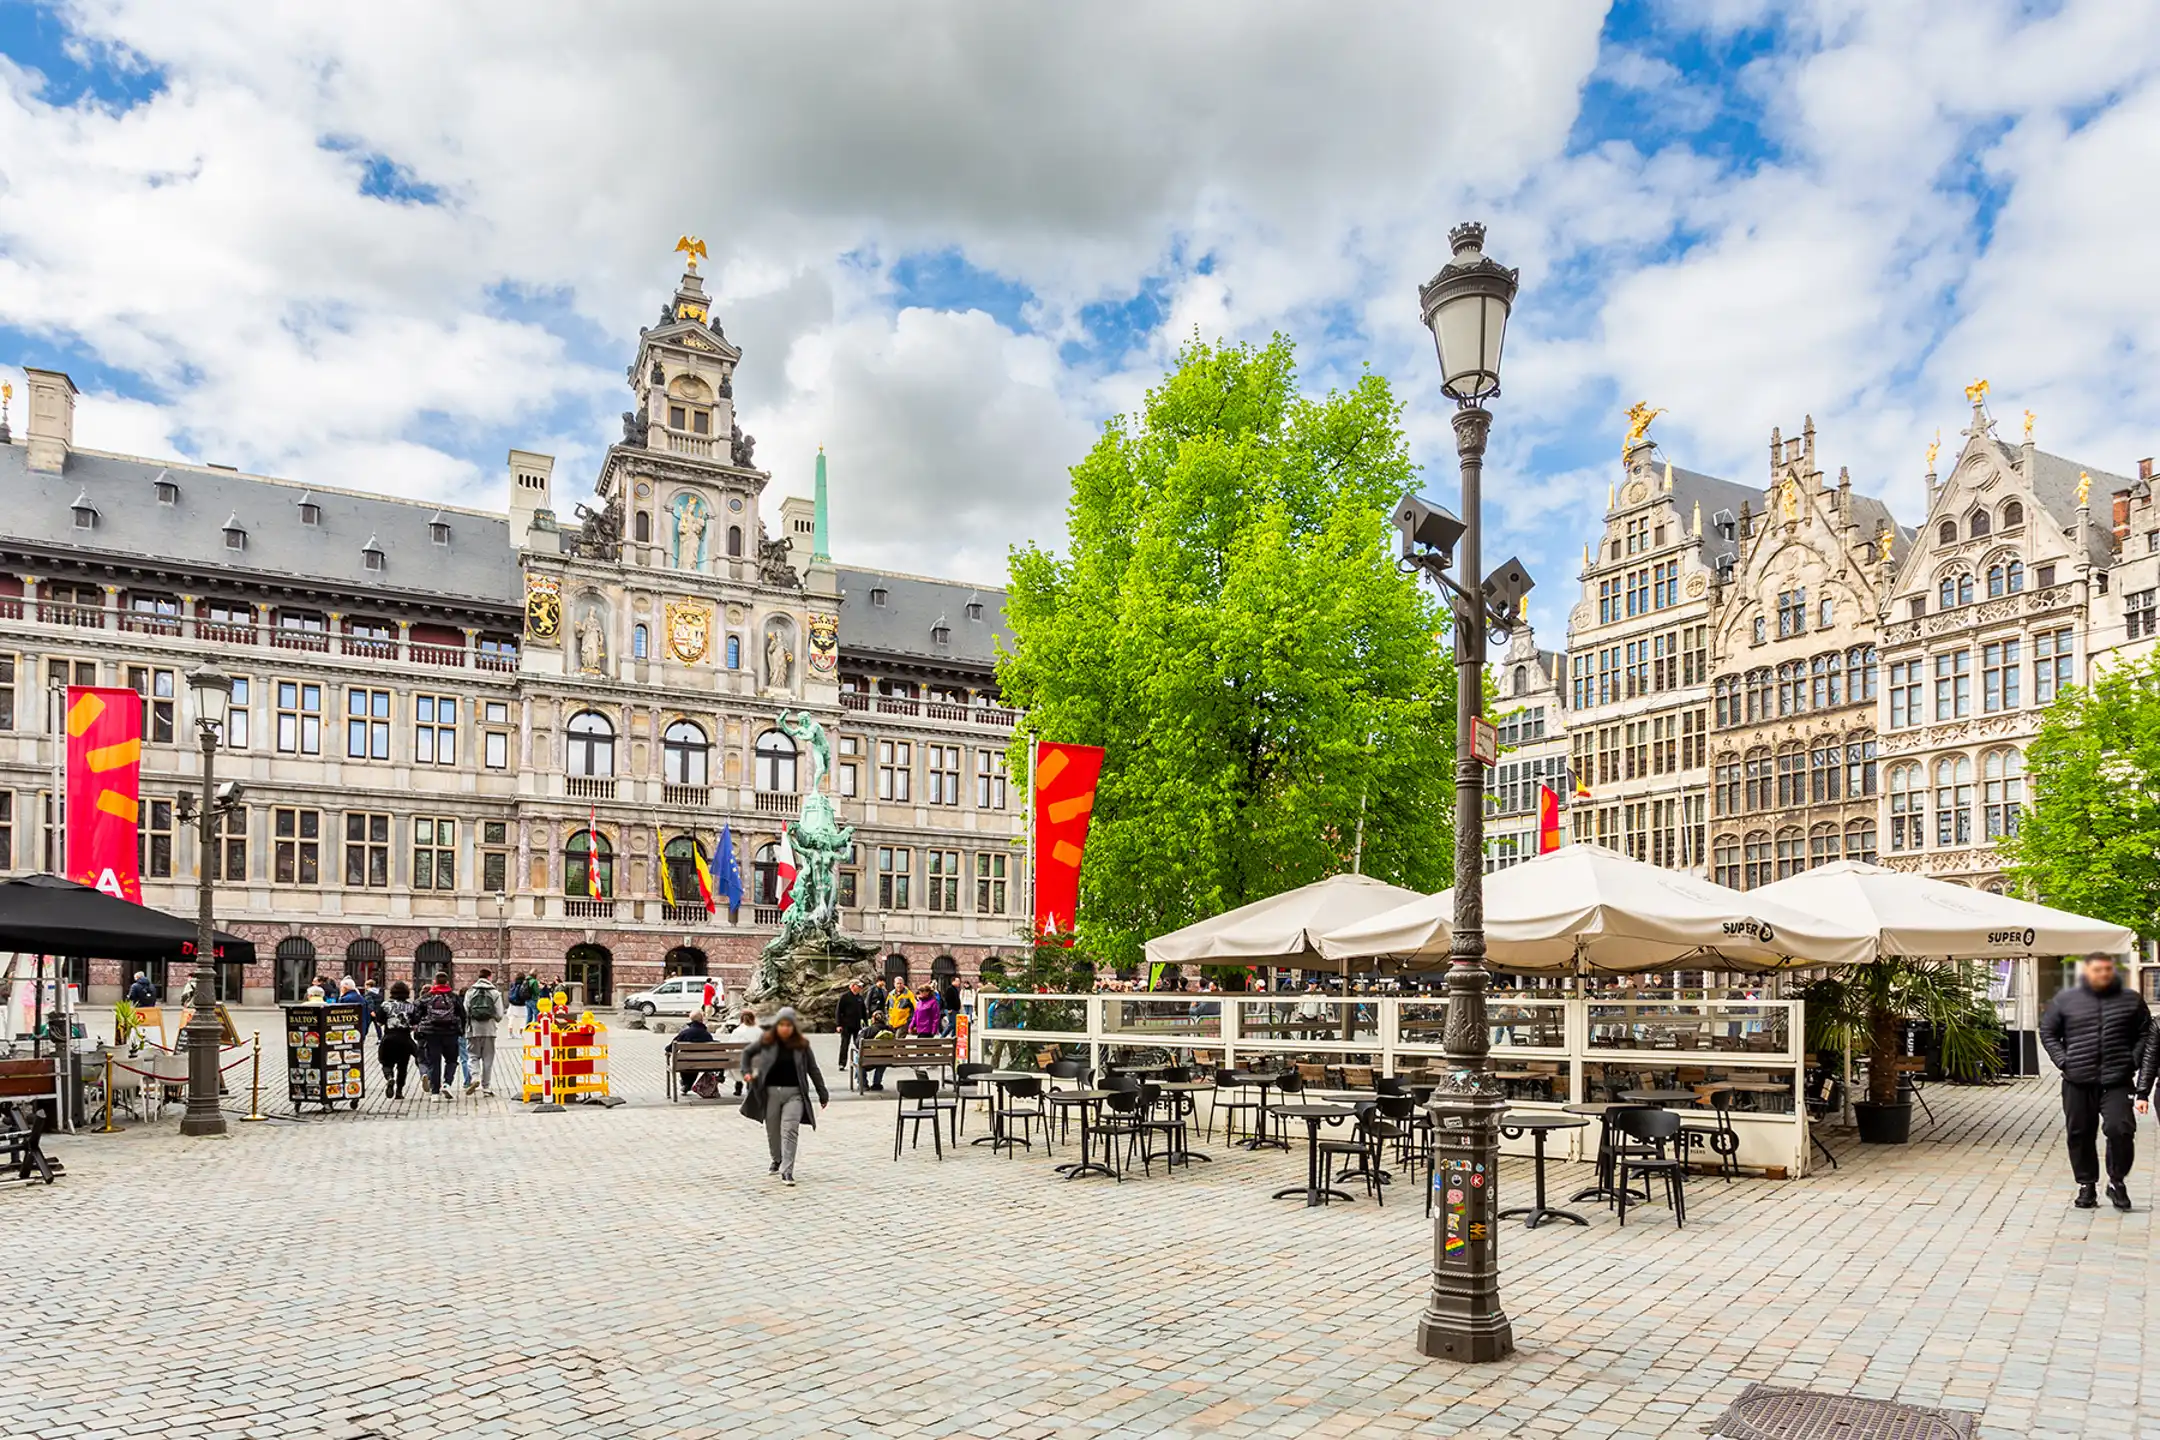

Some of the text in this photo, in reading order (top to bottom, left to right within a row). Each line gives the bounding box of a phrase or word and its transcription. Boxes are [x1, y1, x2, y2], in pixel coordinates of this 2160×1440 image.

[95, 868, 124, 898] A
[1044, 911, 1057, 936] A
[1722, 922, 1758, 936] SUPER
[1987, 931, 2021, 943] SUPER
[326, 1014, 359, 1024] BALTO'S
